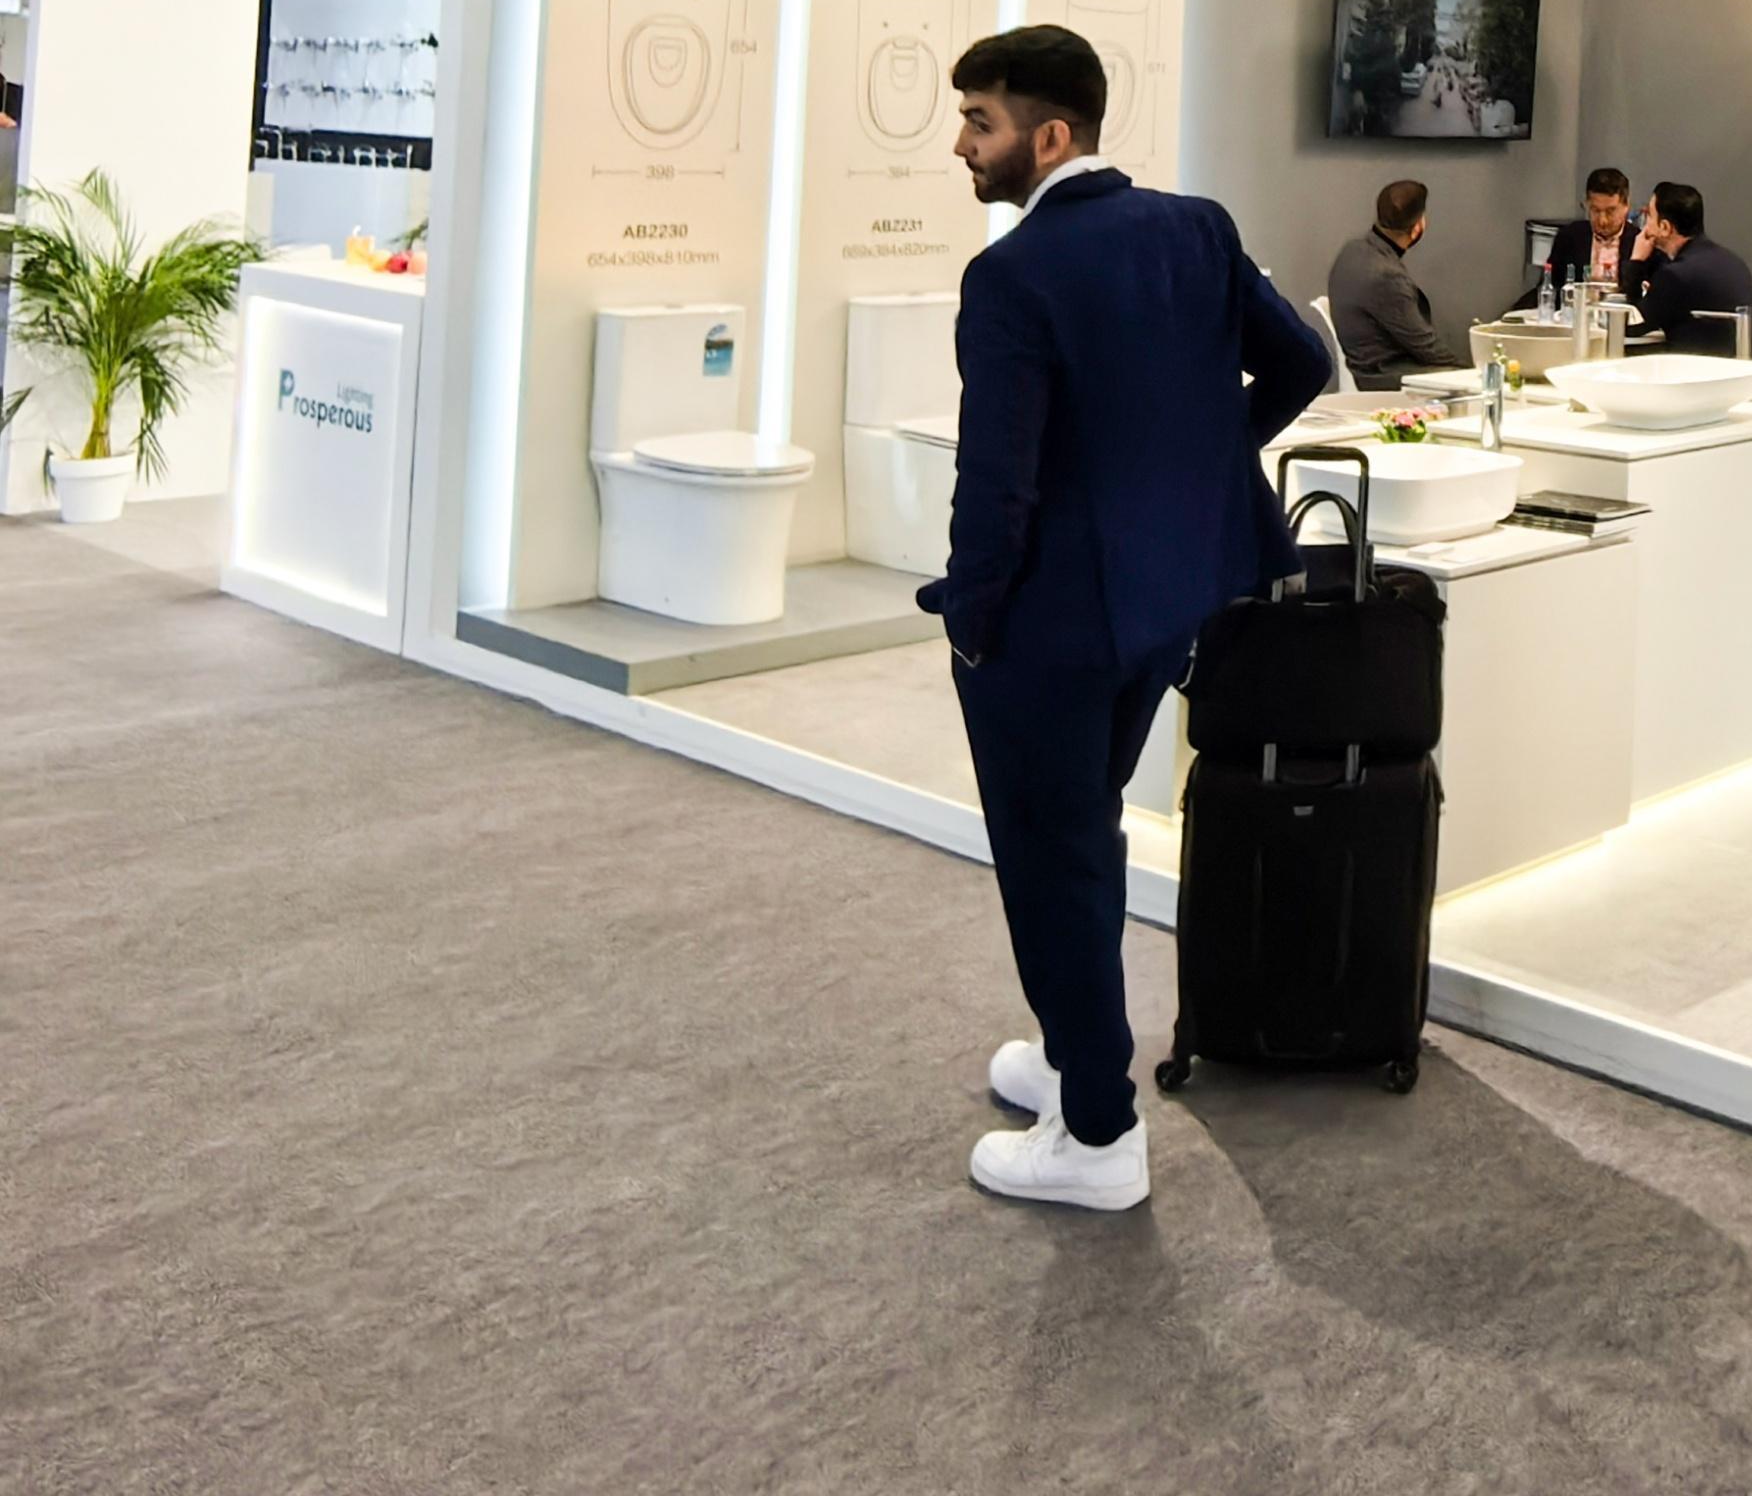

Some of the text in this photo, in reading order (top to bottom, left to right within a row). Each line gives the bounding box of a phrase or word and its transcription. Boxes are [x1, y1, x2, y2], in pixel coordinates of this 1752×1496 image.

[645, 164, 675, 180] 398
[623, 223, 689, 239] AB2230
[872, 218, 923, 233] AB2231
[278, 369, 373, 433] Prosperous
